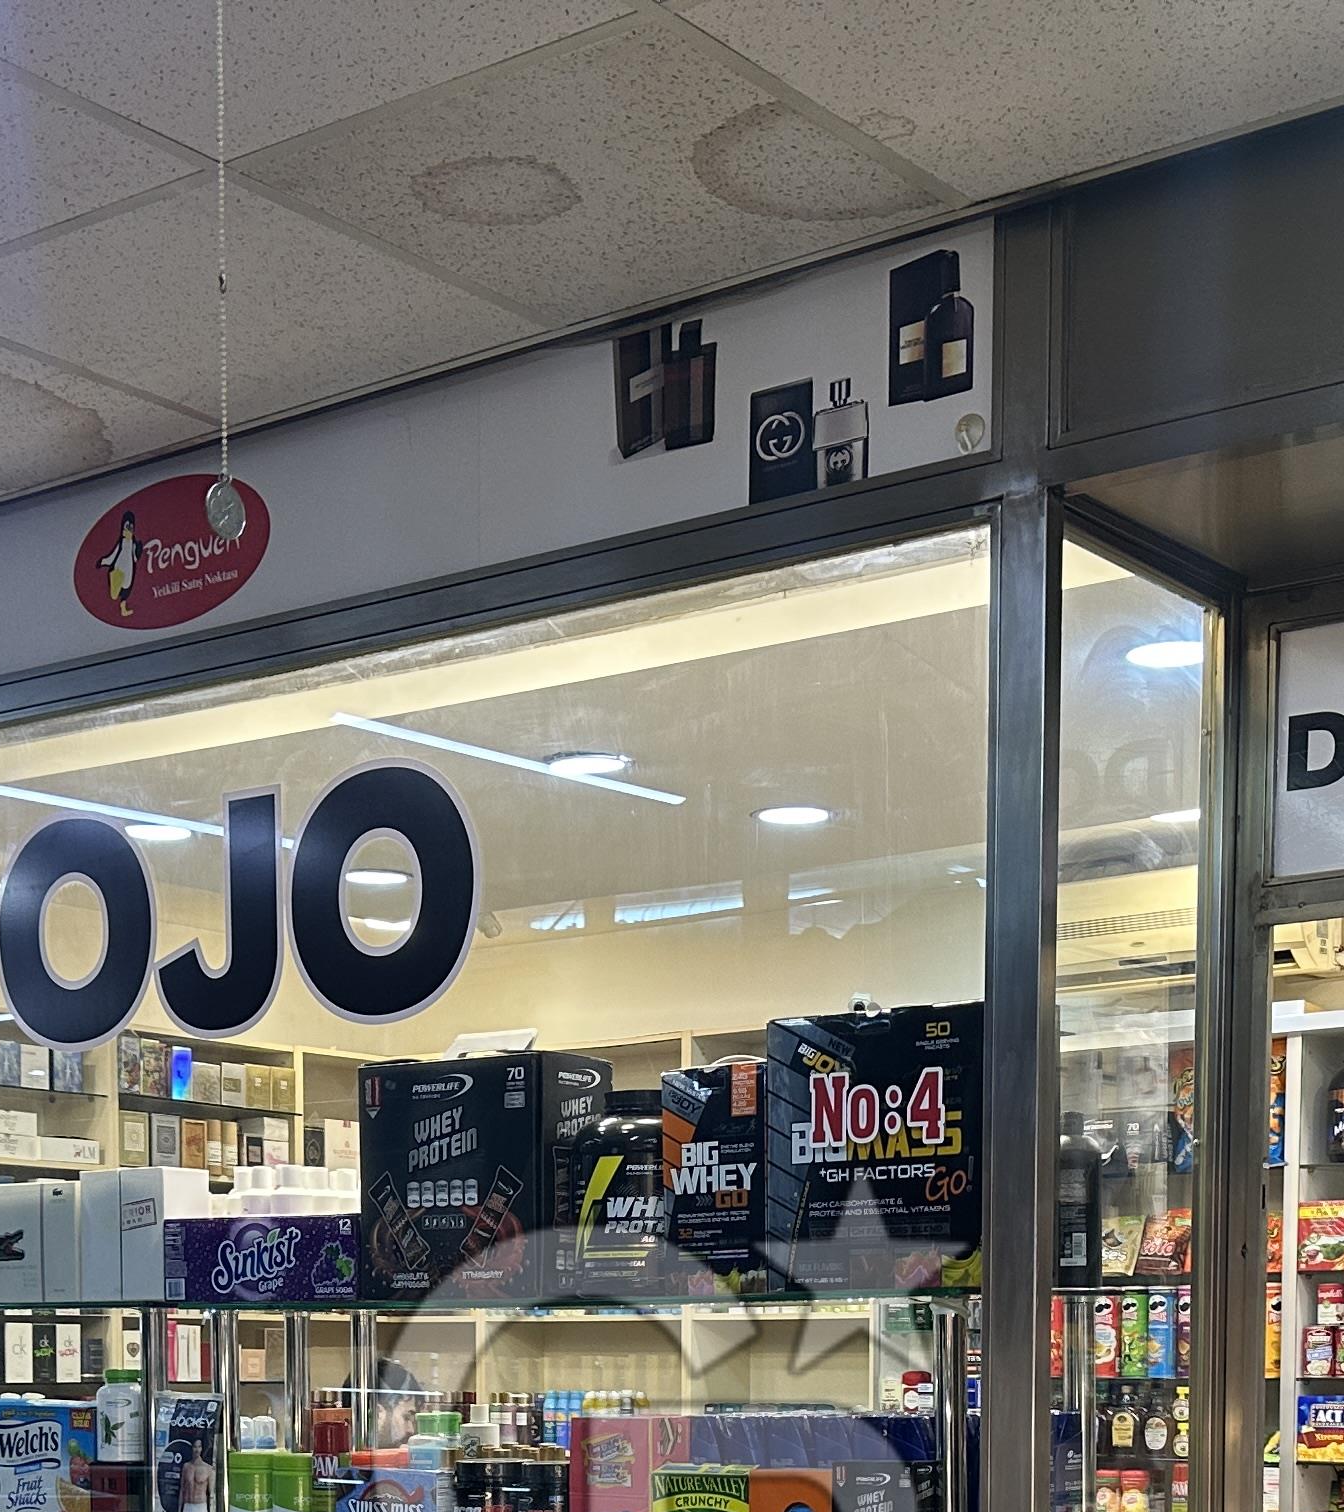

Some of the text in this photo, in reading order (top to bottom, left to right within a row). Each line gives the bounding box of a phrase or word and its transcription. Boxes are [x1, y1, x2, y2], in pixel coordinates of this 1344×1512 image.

[152, 569, 238, 599] Yetkili Satış Noktası
[926, 1022, 950, 1037] 50
[507, 1067, 524, 1080] 70
[561, 1096, 594, 1117] WHEY
[810, 1066, 945, 1148] No:4
[414, 1106, 464, 1143] WHEY
[408, 1127, 478, 1172] PROTEIN
[681, 1141, 719, 1168] BIG
[670, 1163, 757, 1194] WHEY
[854, 1163, 936, 1180] FACTORS
[716, 1189, 748, 1208] GO
[338, 1219, 351, 1230] 12
[258, 1278, 284, 1293] Grape
[1316, 1409, 1339, 1424] ACT
[15, 1476, 44, 1494] Fruit
[654, 1474, 748, 1499] NATURE VALLEY
[7, 1488, 47, 1510] Snacks
[675, 1496, 730, 1509] CRUNCHY
[857, 1490, 887, 1507] WHEY
